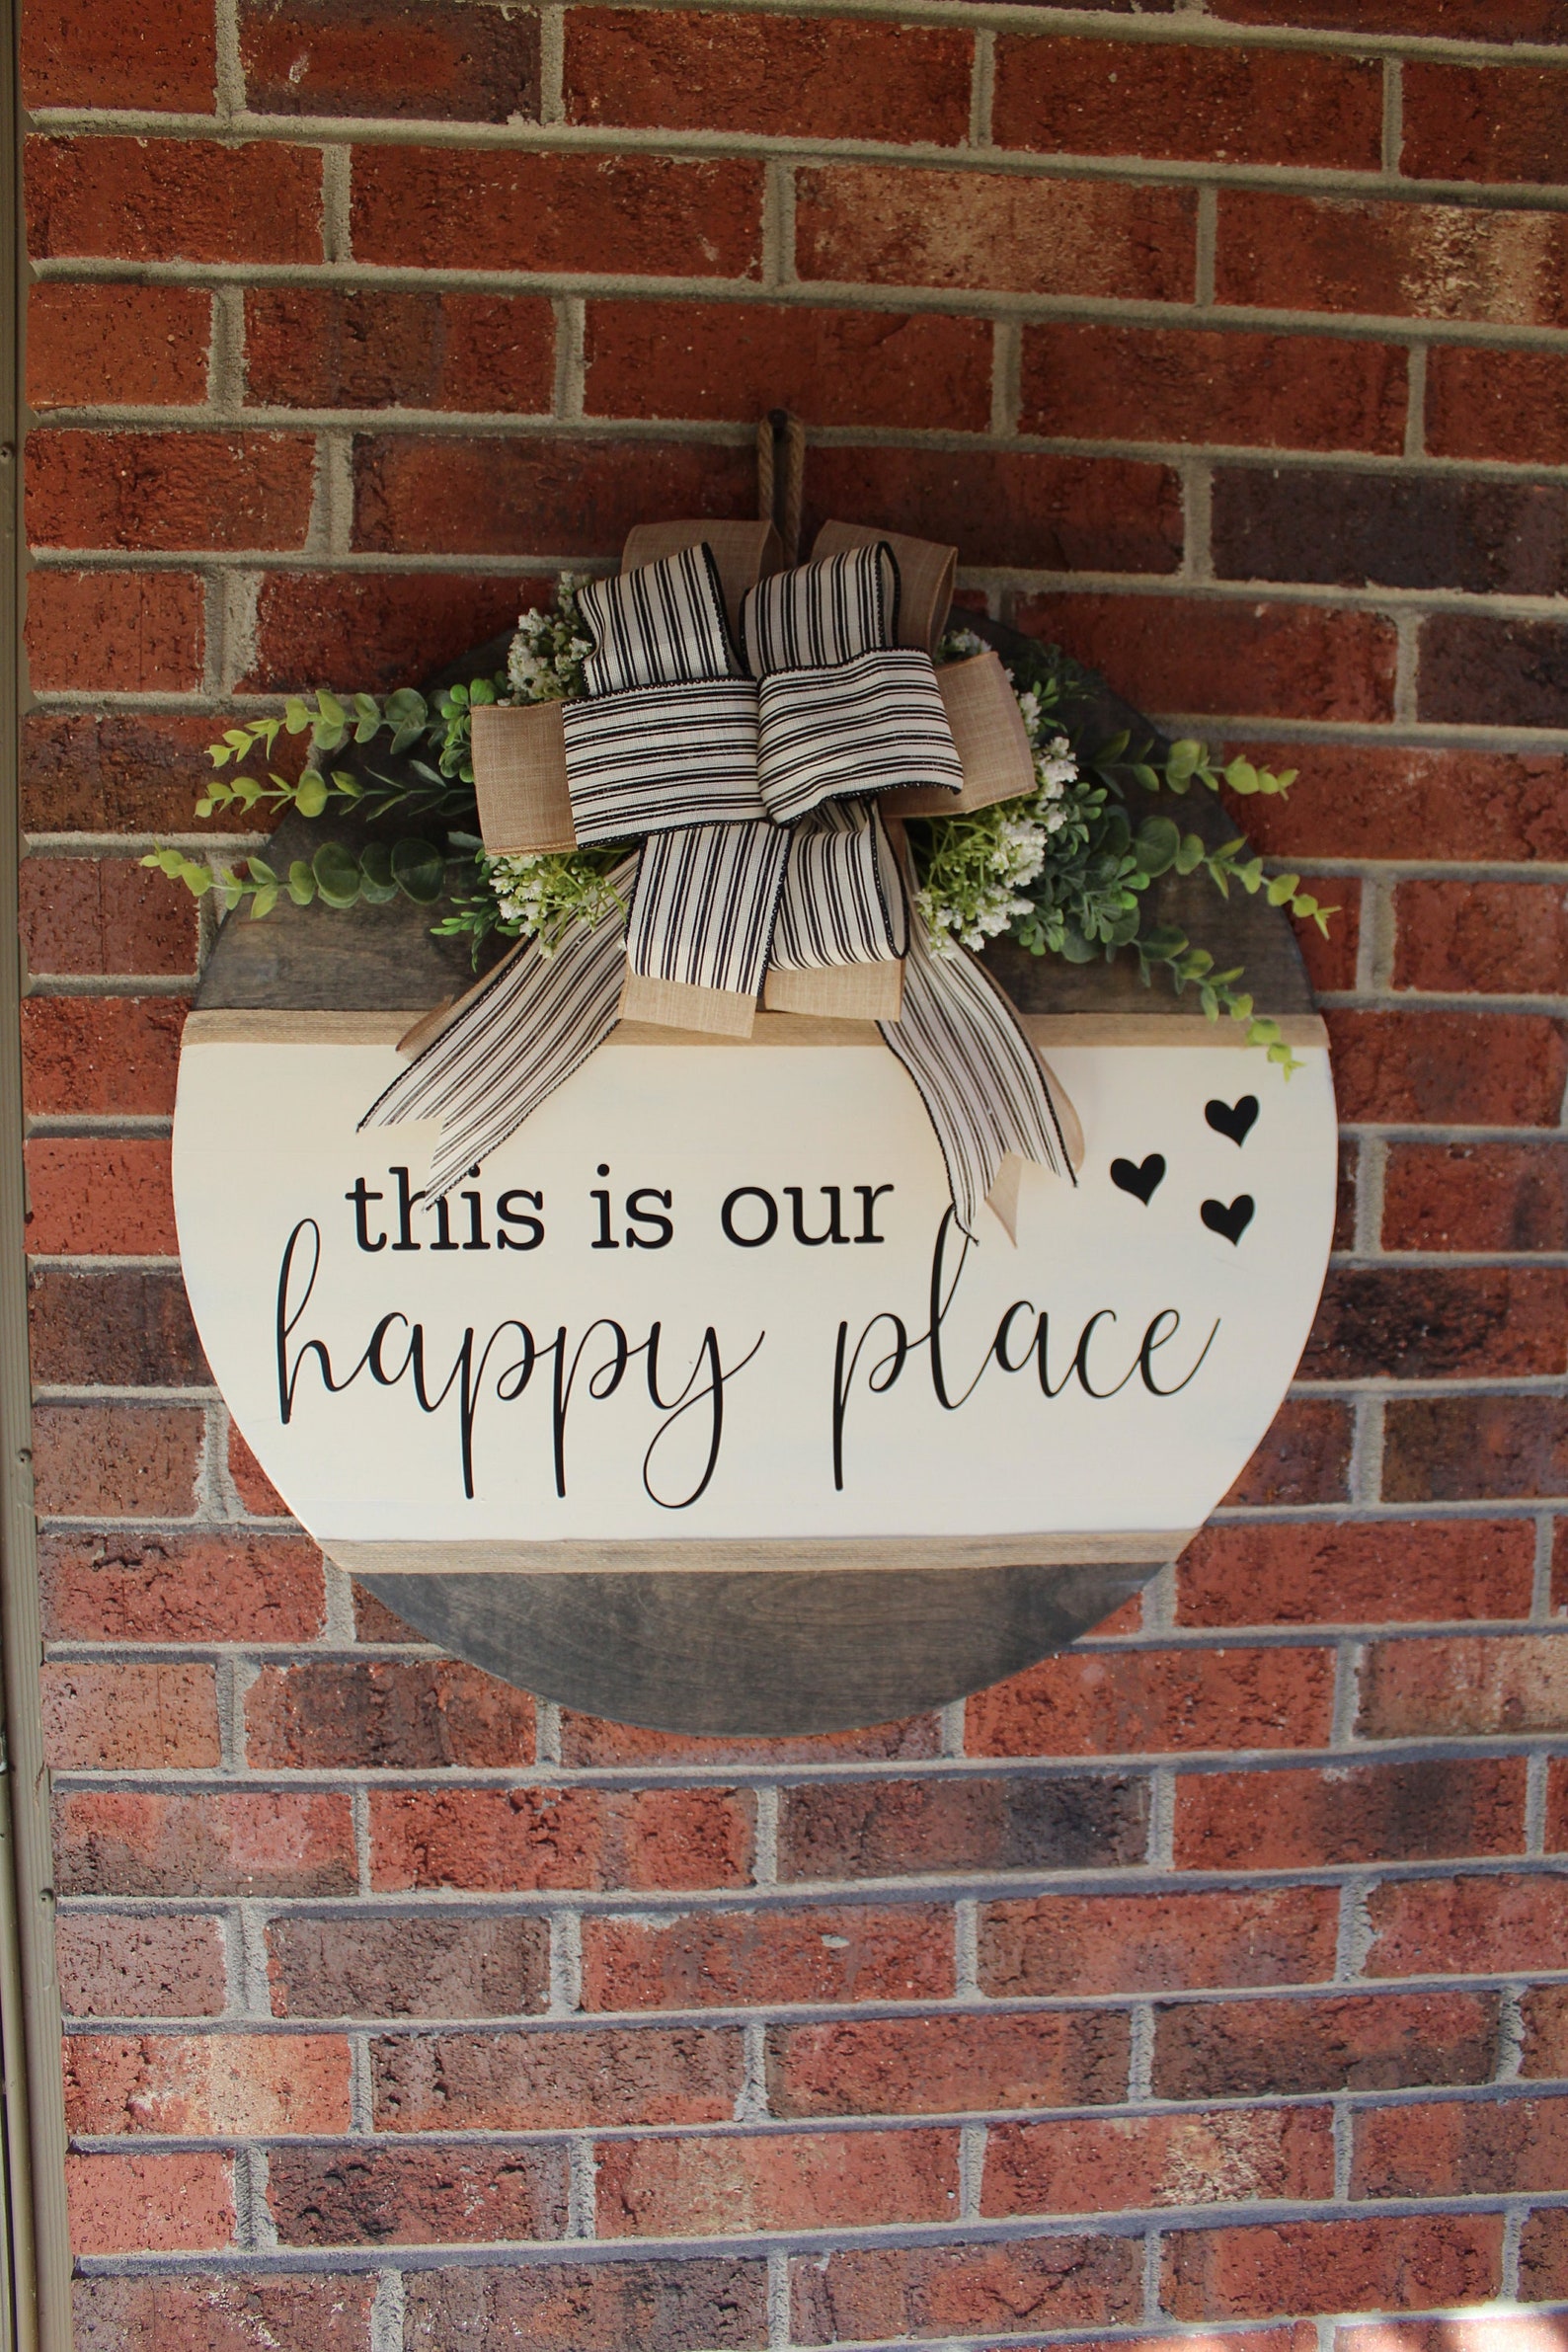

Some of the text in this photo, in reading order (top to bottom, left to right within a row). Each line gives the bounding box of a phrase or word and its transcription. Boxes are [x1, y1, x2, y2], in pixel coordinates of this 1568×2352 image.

[345, 1163, 895, 1252] this is our
[276, 1201, 1220, 1510] happy place
